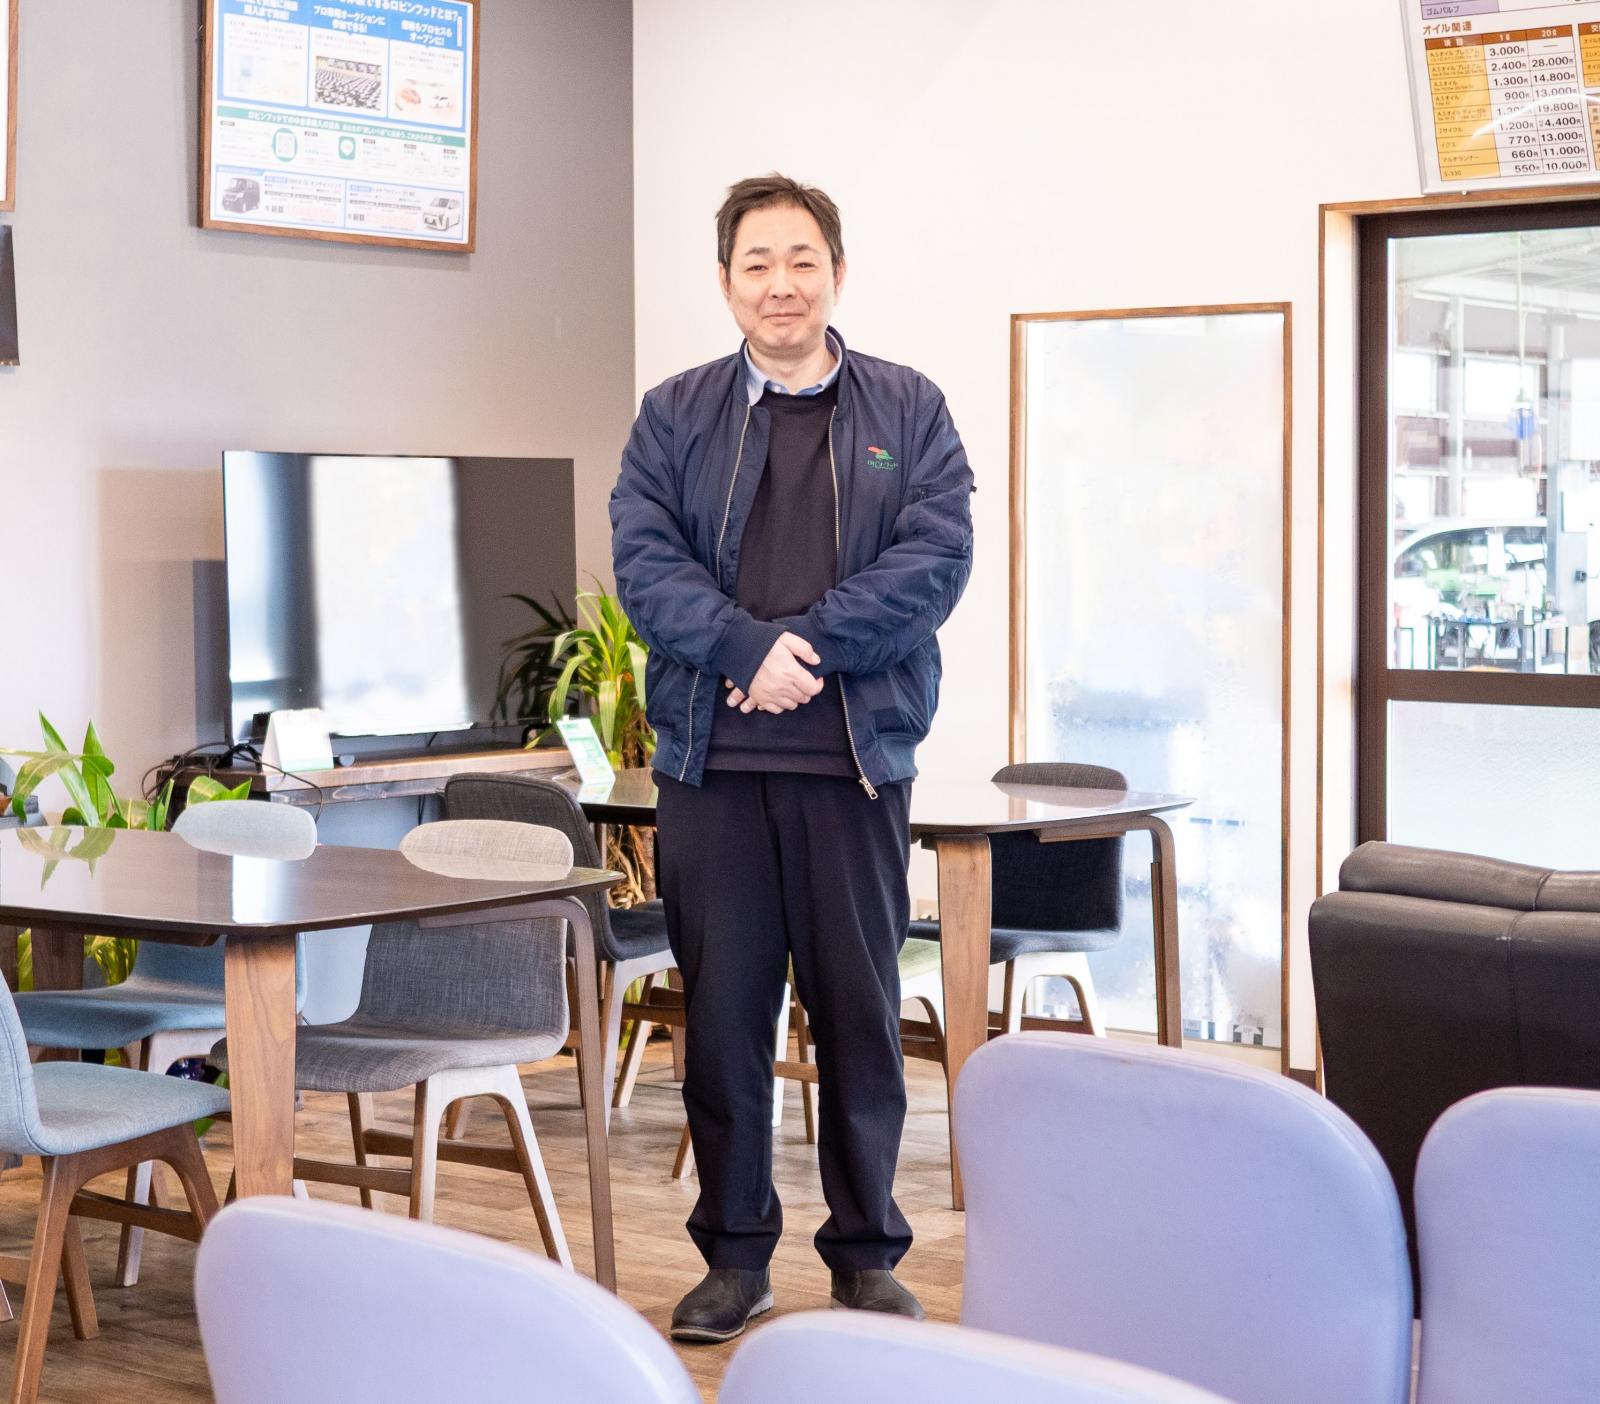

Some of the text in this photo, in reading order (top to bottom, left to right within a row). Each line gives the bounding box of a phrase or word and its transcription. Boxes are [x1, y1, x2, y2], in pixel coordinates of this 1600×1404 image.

[1423, 21, 1473, 36] オイル関連
